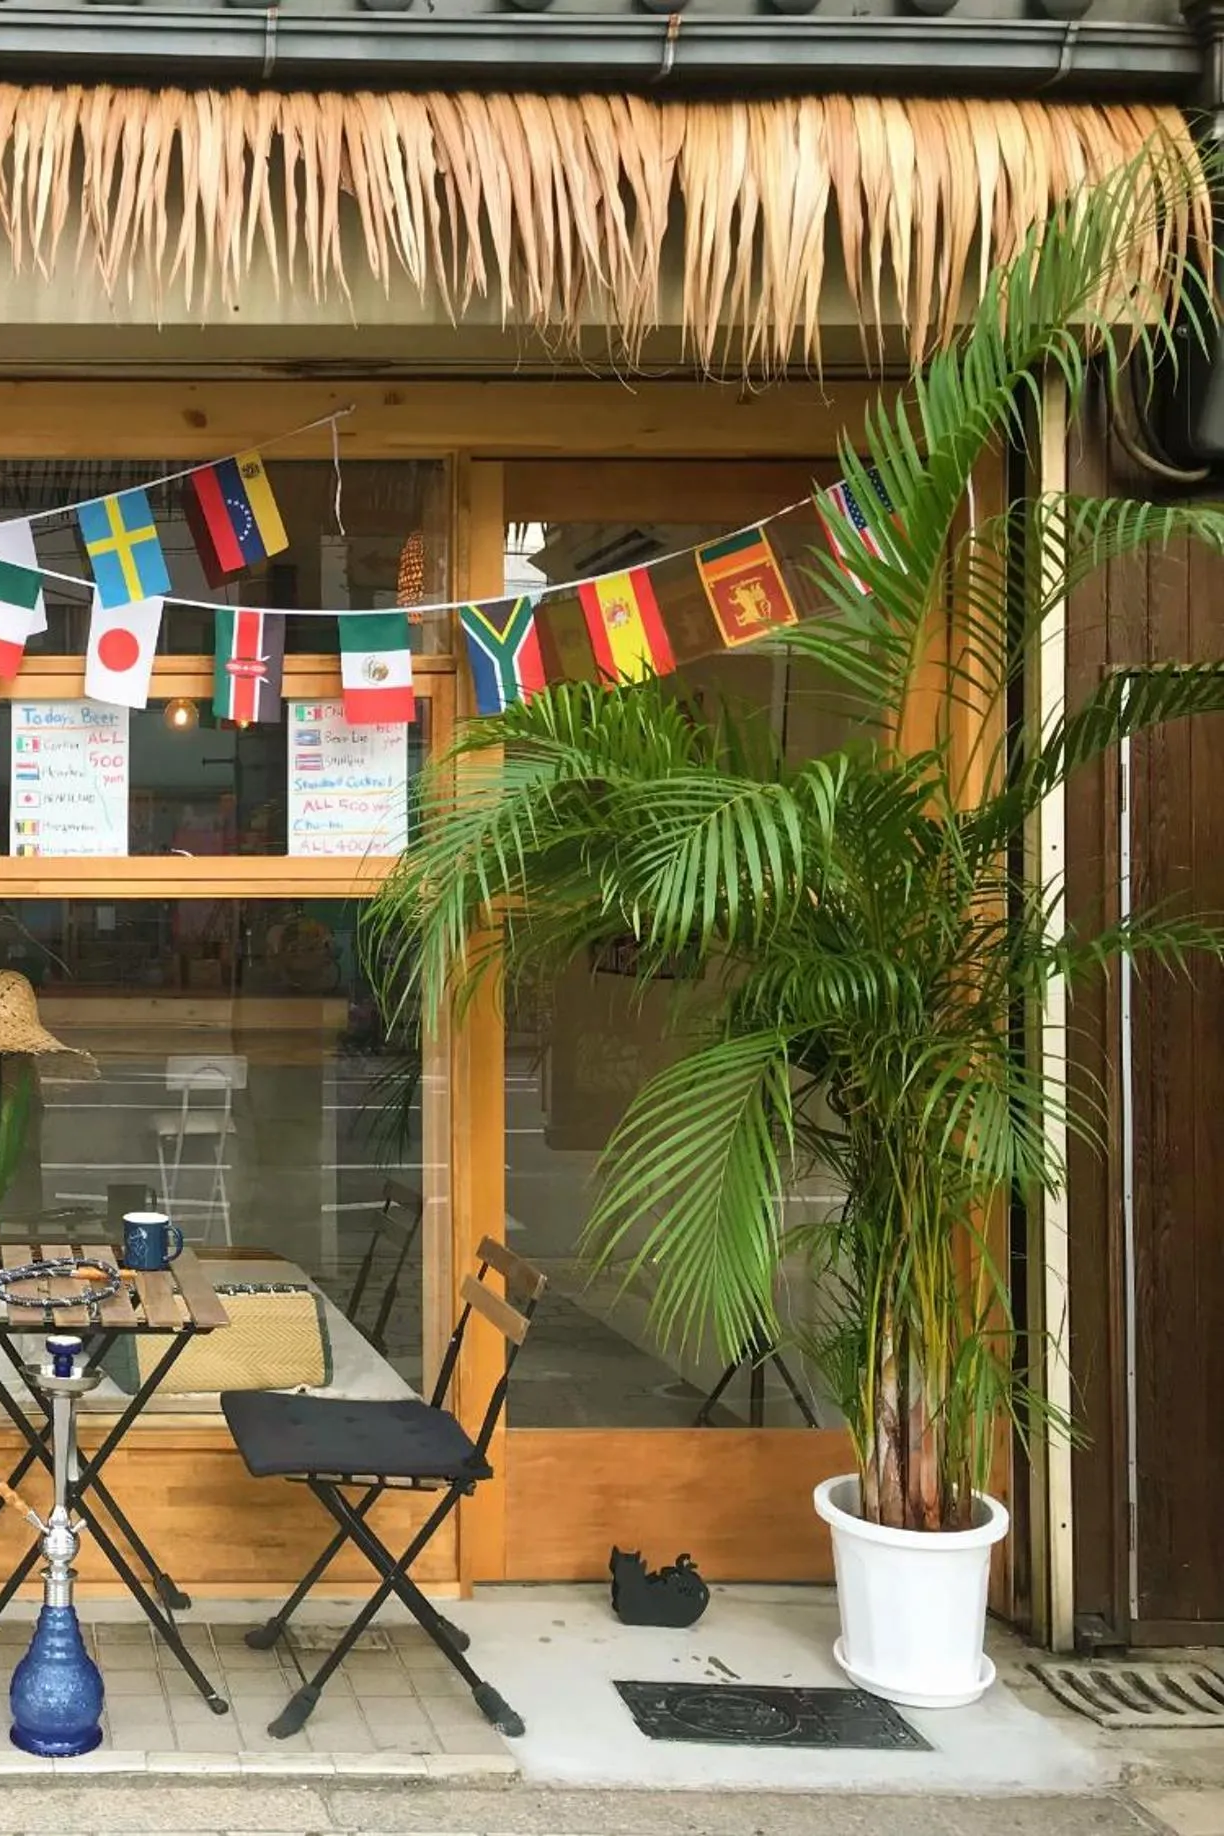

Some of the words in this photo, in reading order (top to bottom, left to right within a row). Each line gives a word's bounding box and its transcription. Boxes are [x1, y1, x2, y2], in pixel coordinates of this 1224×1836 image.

[88, 731, 125, 745] ALL
[89, 752, 124, 769] 500
[303, 799, 334, 814] ALL
